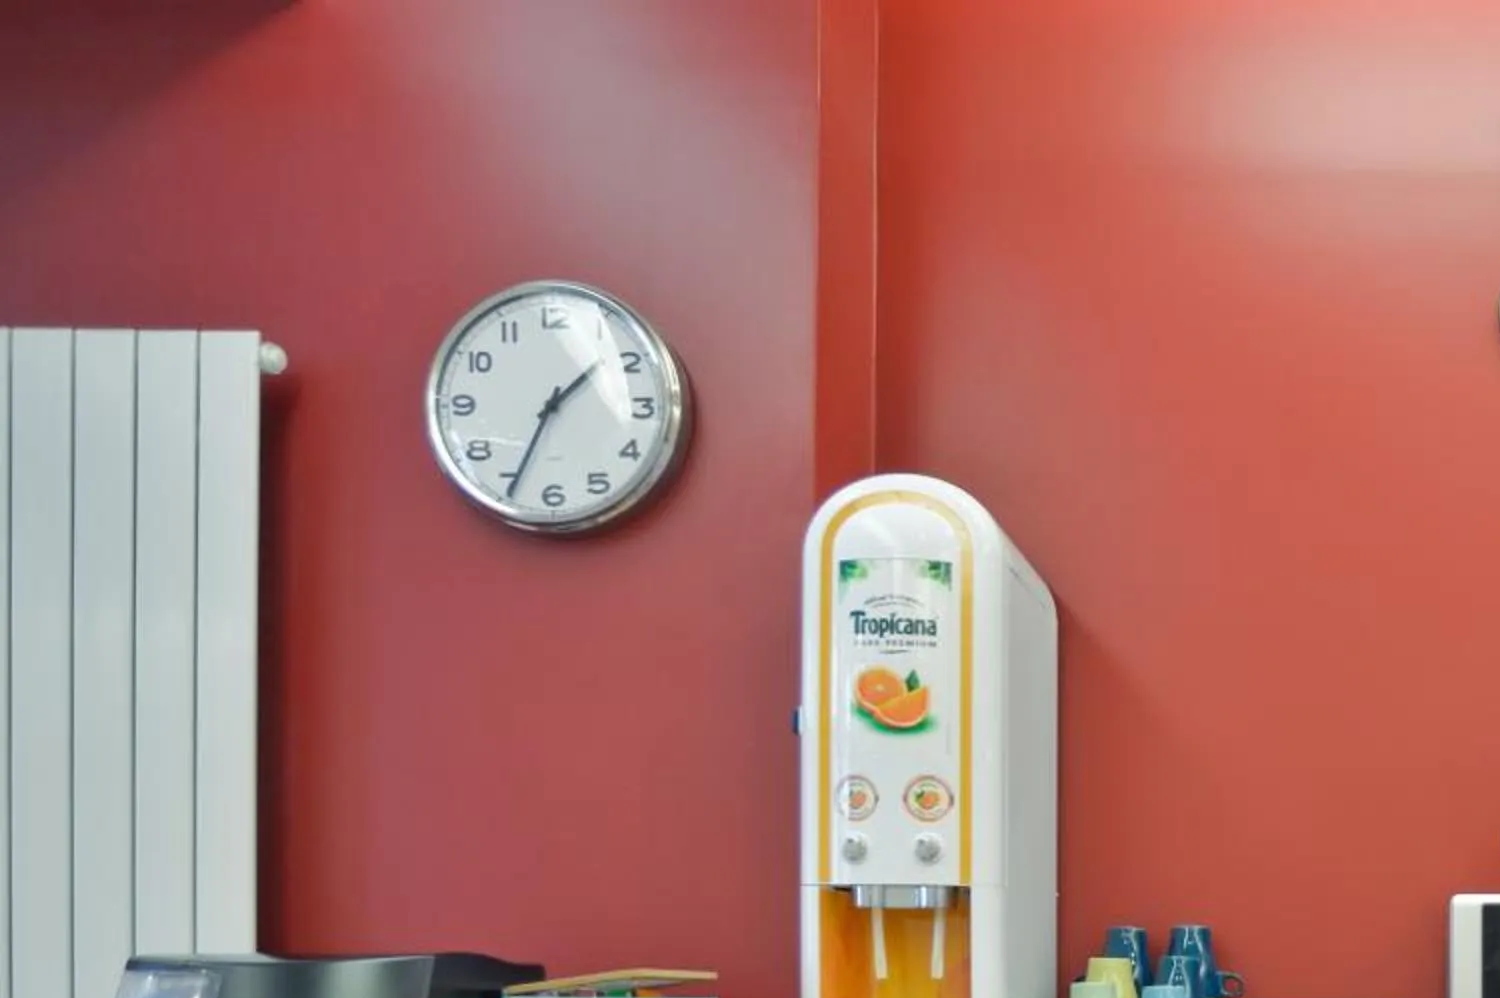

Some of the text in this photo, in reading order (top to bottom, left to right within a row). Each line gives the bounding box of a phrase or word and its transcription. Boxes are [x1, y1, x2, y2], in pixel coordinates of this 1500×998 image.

[541, 307, 570, 329] 12
[501, 321, 518, 343] 11
[468, 351, 492, 373] 10
[619, 352, 642, 373] 2
[452, 394, 476, 416] 9
[632, 397, 654, 419] 3
[466, 440, 492, 461] 8
[618, 439, 641, 461] 4
[587, 473, 610, 494] 5
[541, 485, 566, 506] 6
[850, 610, 938, 638] Tropicana
